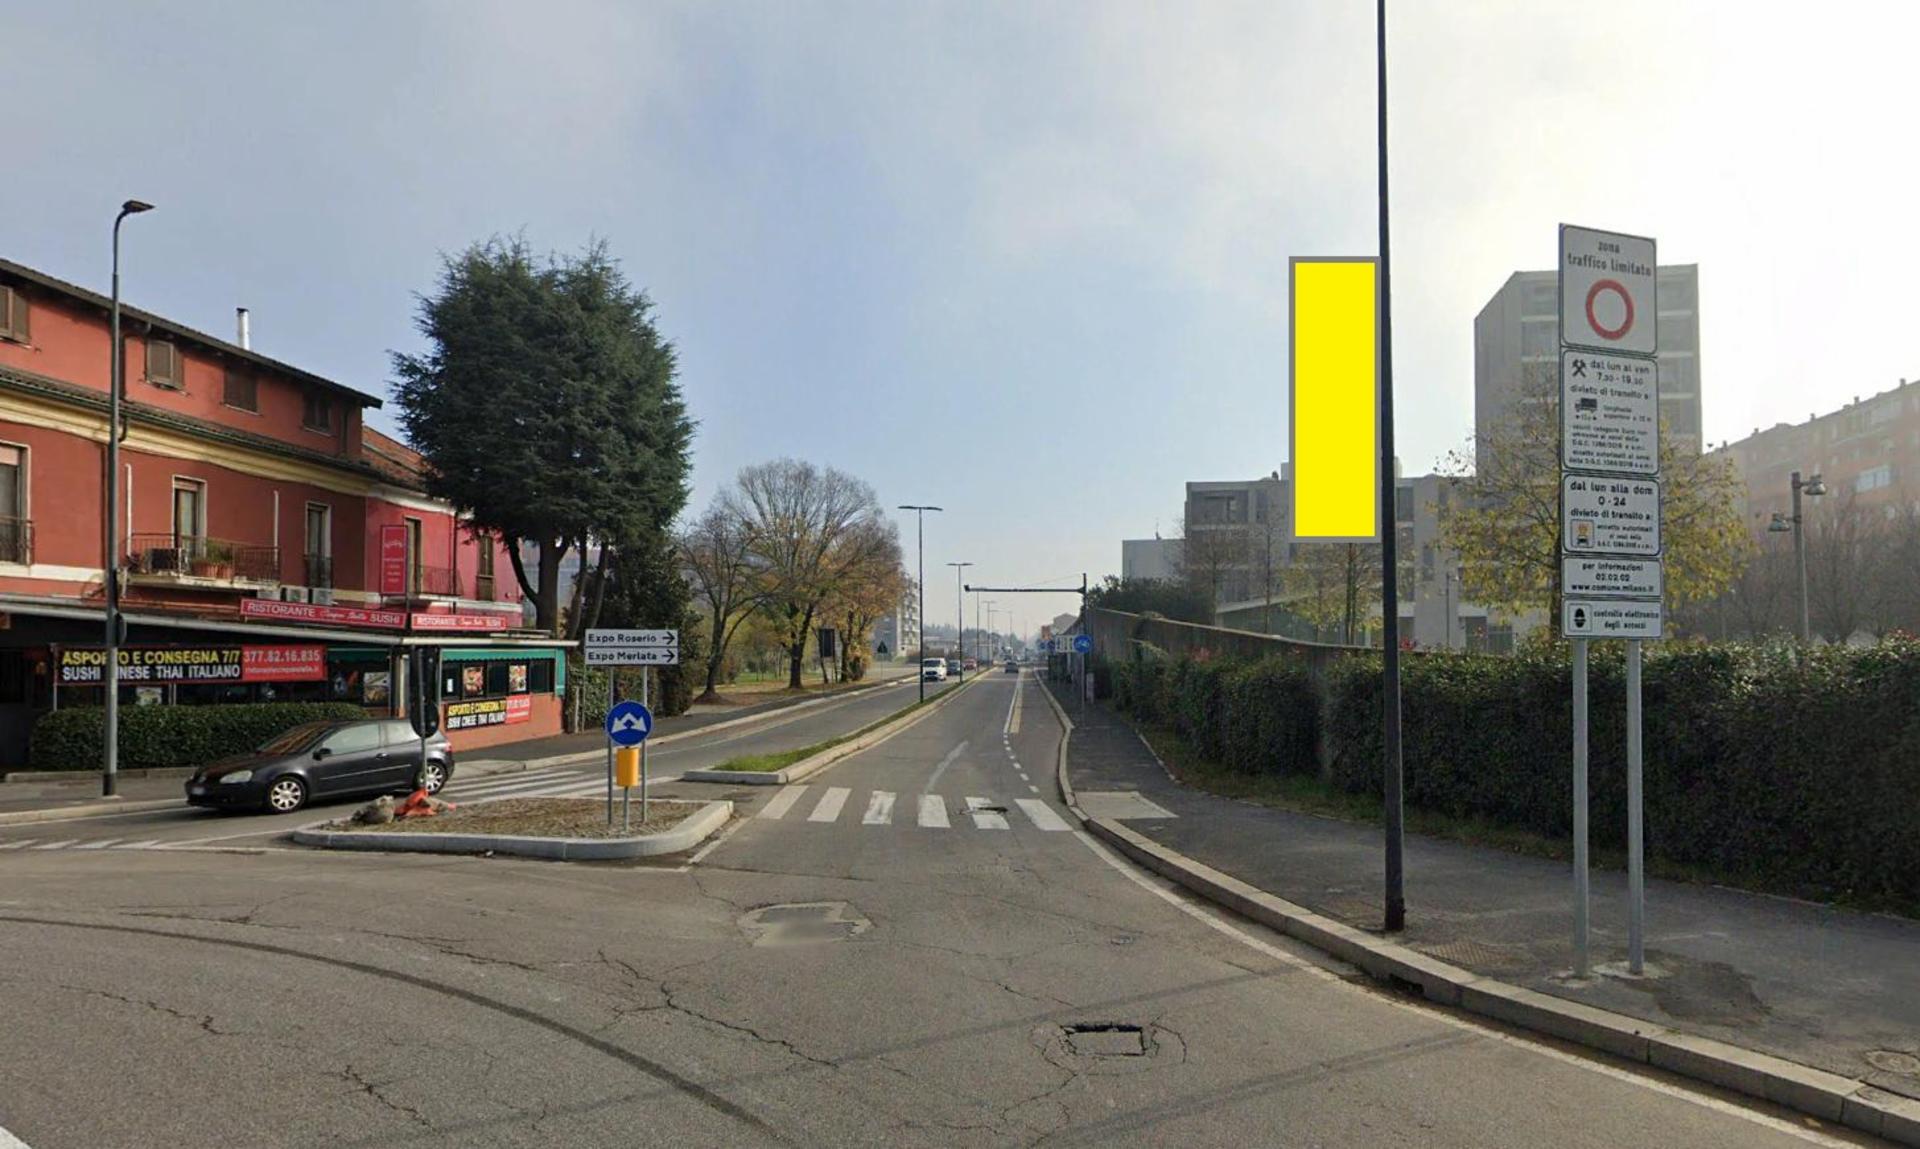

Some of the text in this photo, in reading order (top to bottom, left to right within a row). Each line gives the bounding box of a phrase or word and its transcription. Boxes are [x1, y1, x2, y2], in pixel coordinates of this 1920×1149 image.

[1598, 241, 1620, 253] zona
[1568, 253, 1651, 277] traffico limitato
[1591, 360, 1605, 370] dal
[1607, 360, 1621, 371] lun
[1570, 481, 1653, 495] dal lun alla dom
[1598, 496, 1605, 506] 0
[1613, 497, 1626, 506] 24
[1570, 508, 1599, 518] divieto
[1601, 510, 1609, 518] di
[1611, 510, 1644, 520] transito
[1582, 562, 1644, 571] per informazioni
[247, 602, 315, 617] RISTORANTE
[369, 613, 400, 624] SUSHI
[588, 633, 657, 643] Expo Roserio
[133, 651, 141, 664] E
[144, 650, 219, 664] CONSEGNA
[588, 652, 657, 662] Expo Merlata
[63, 665, 101, 680] SUSHI
[155, 664, 183, 679] THAI
[188, 663, 240, 678] ITALIANO
